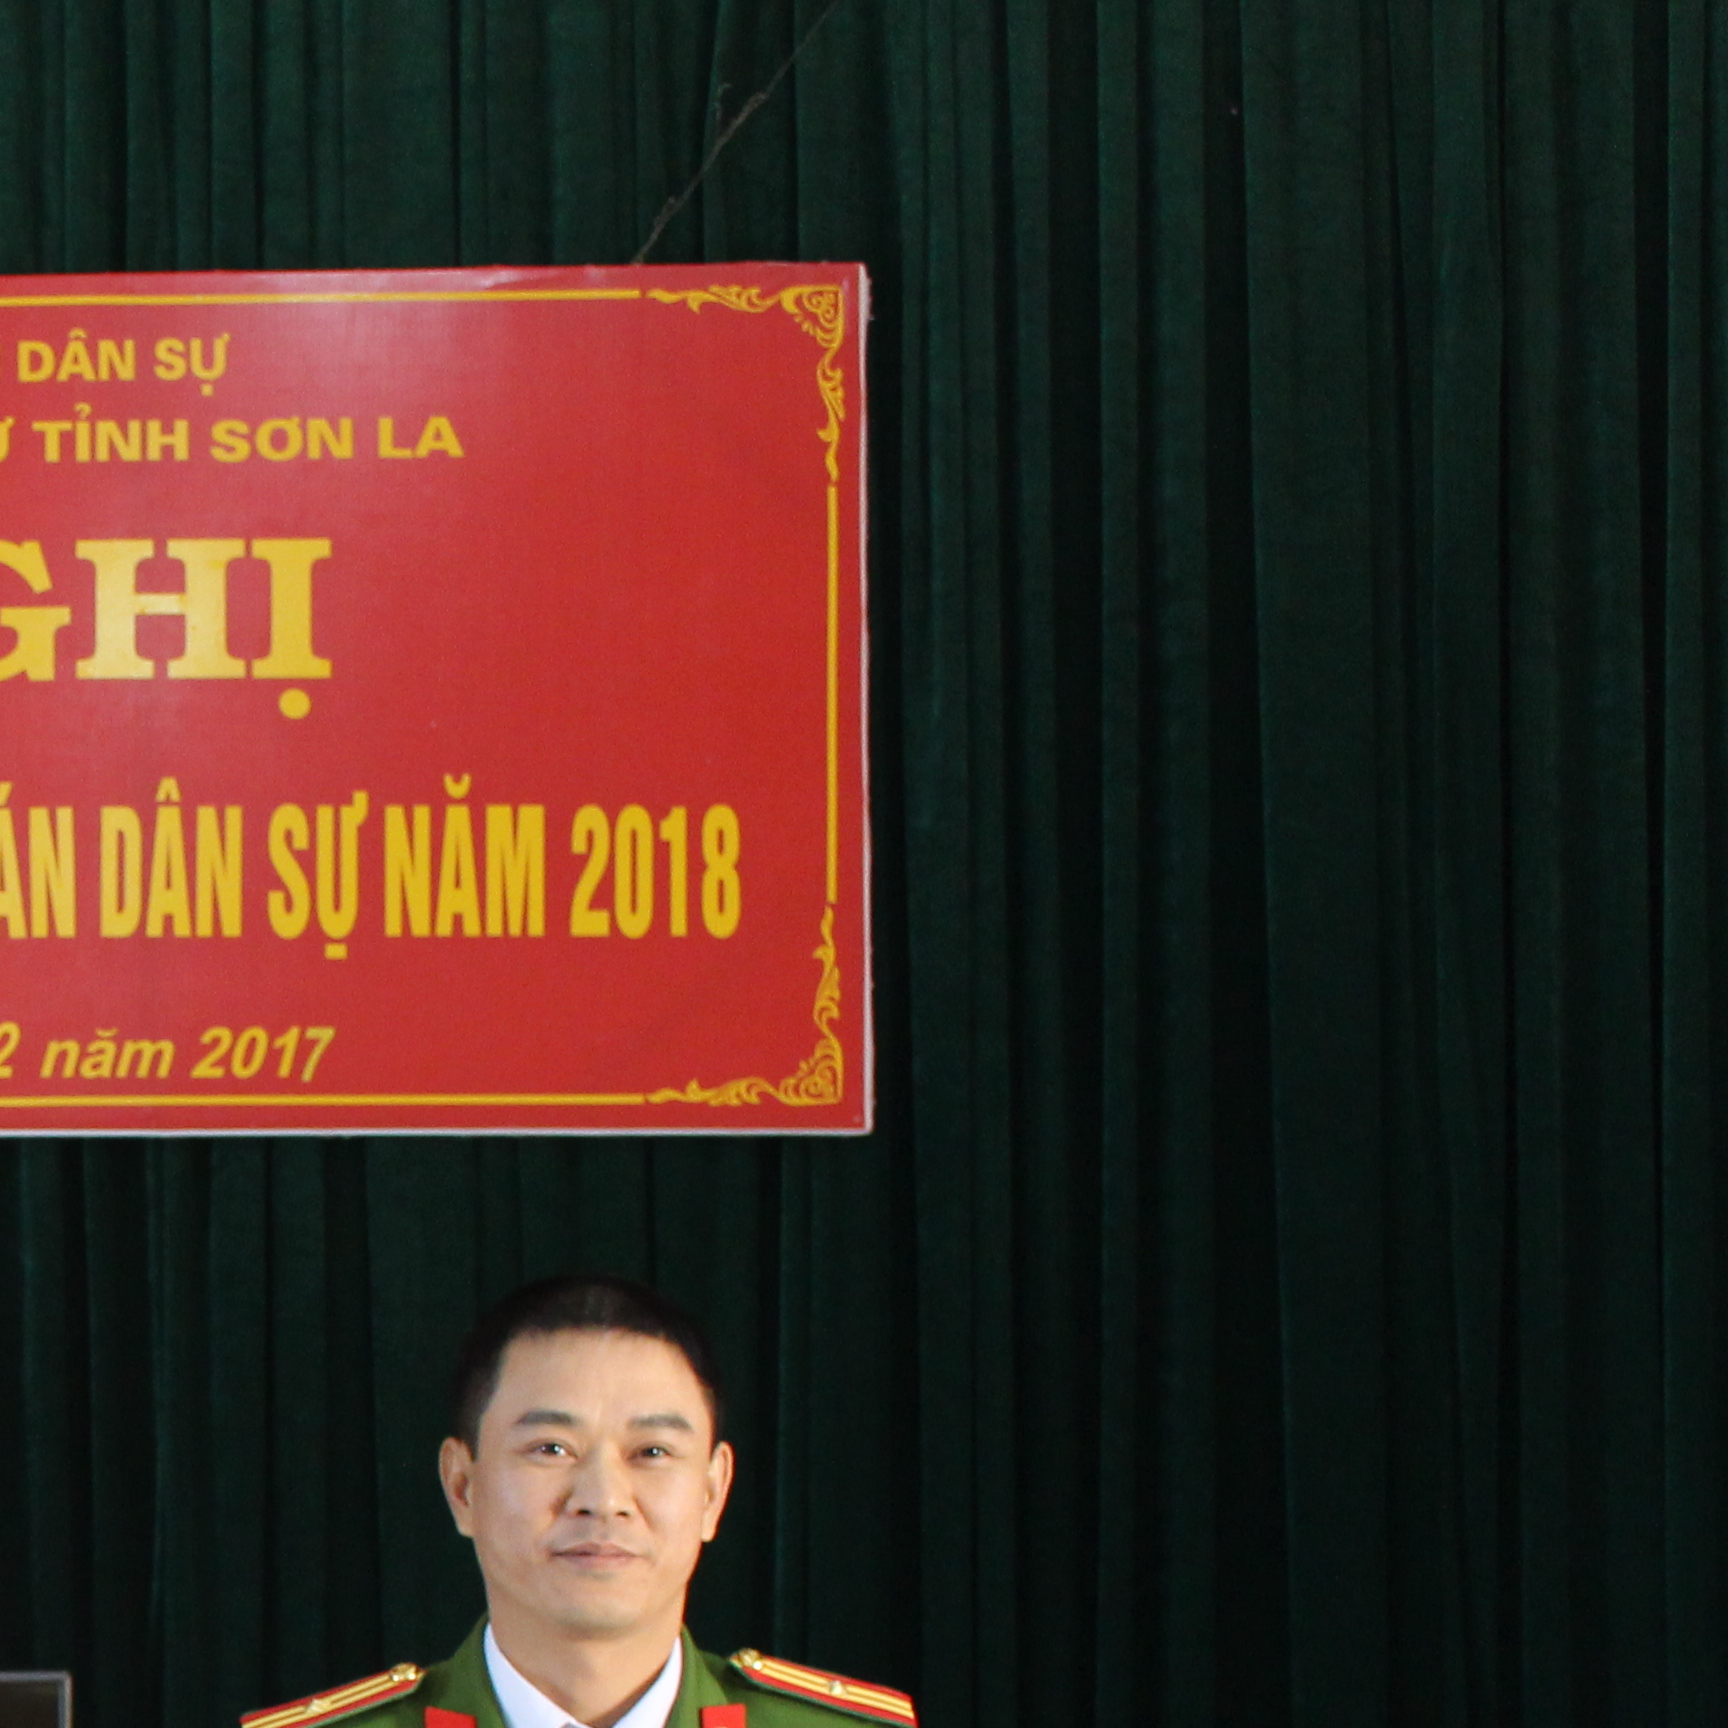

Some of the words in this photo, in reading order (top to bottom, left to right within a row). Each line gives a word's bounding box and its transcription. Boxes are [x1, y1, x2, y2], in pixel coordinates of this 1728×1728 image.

[17, 327, 137, 383] DÂN
[153, 331, 232, 397] SỰ
[31, 401, 190, 464] TỈNH
[209, 414, 355, 464] SƠN
[376, 414, 465, 460] LA
[99, 776, 243, 939] DÂN
[267, 790, 369, 960] SỰ
[384, 773, 545, 938] NĂM
[570, 804, 741, 939] 2018
[40, 1028, 175, 1080] năm
[190, 1026, 336, 1082] 2017
